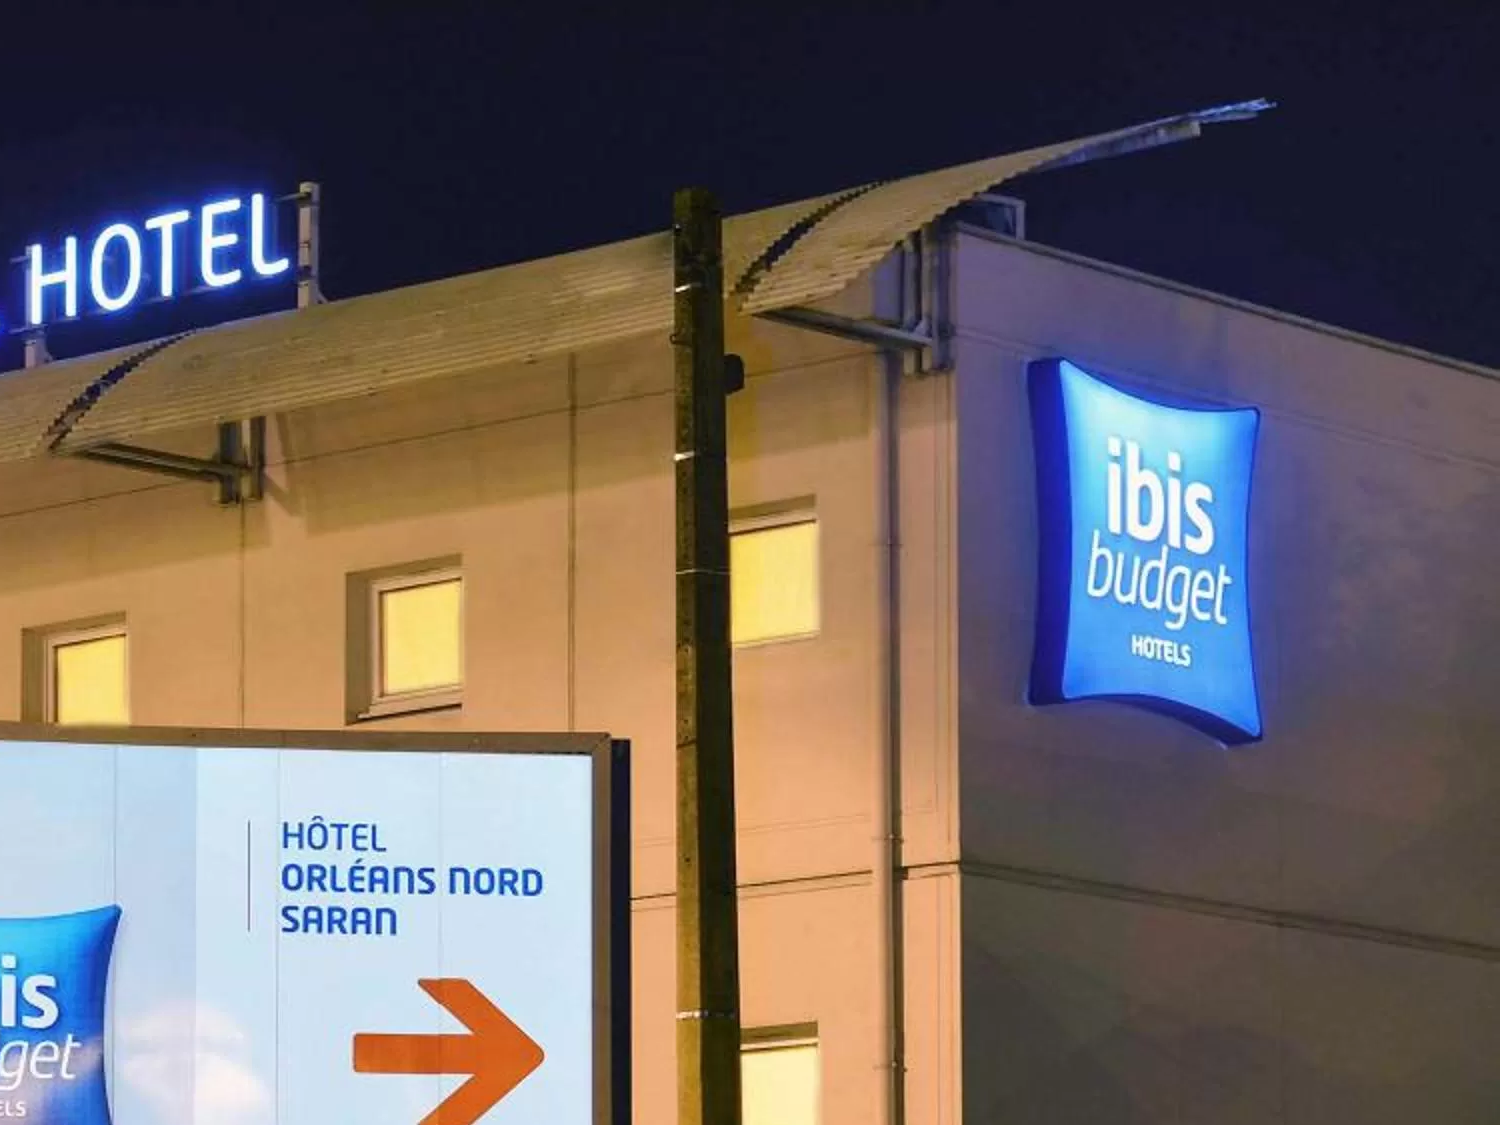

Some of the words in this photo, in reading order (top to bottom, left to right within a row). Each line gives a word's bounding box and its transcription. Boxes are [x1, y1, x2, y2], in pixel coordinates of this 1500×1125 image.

[30, 193, 290, 325] HOTEL
[1107, 435, 1216, 556] ibis
[1087, 528, 1233, 631] budget
[1131, 633, 1191, 667] HOTELS
[282, 815, 387, 853] HÔTEL
[281, 858, 436, 895] ORLÉANS
[448, 866, 544, 898] NORD
[280, 905, 398, 936] SARAN
